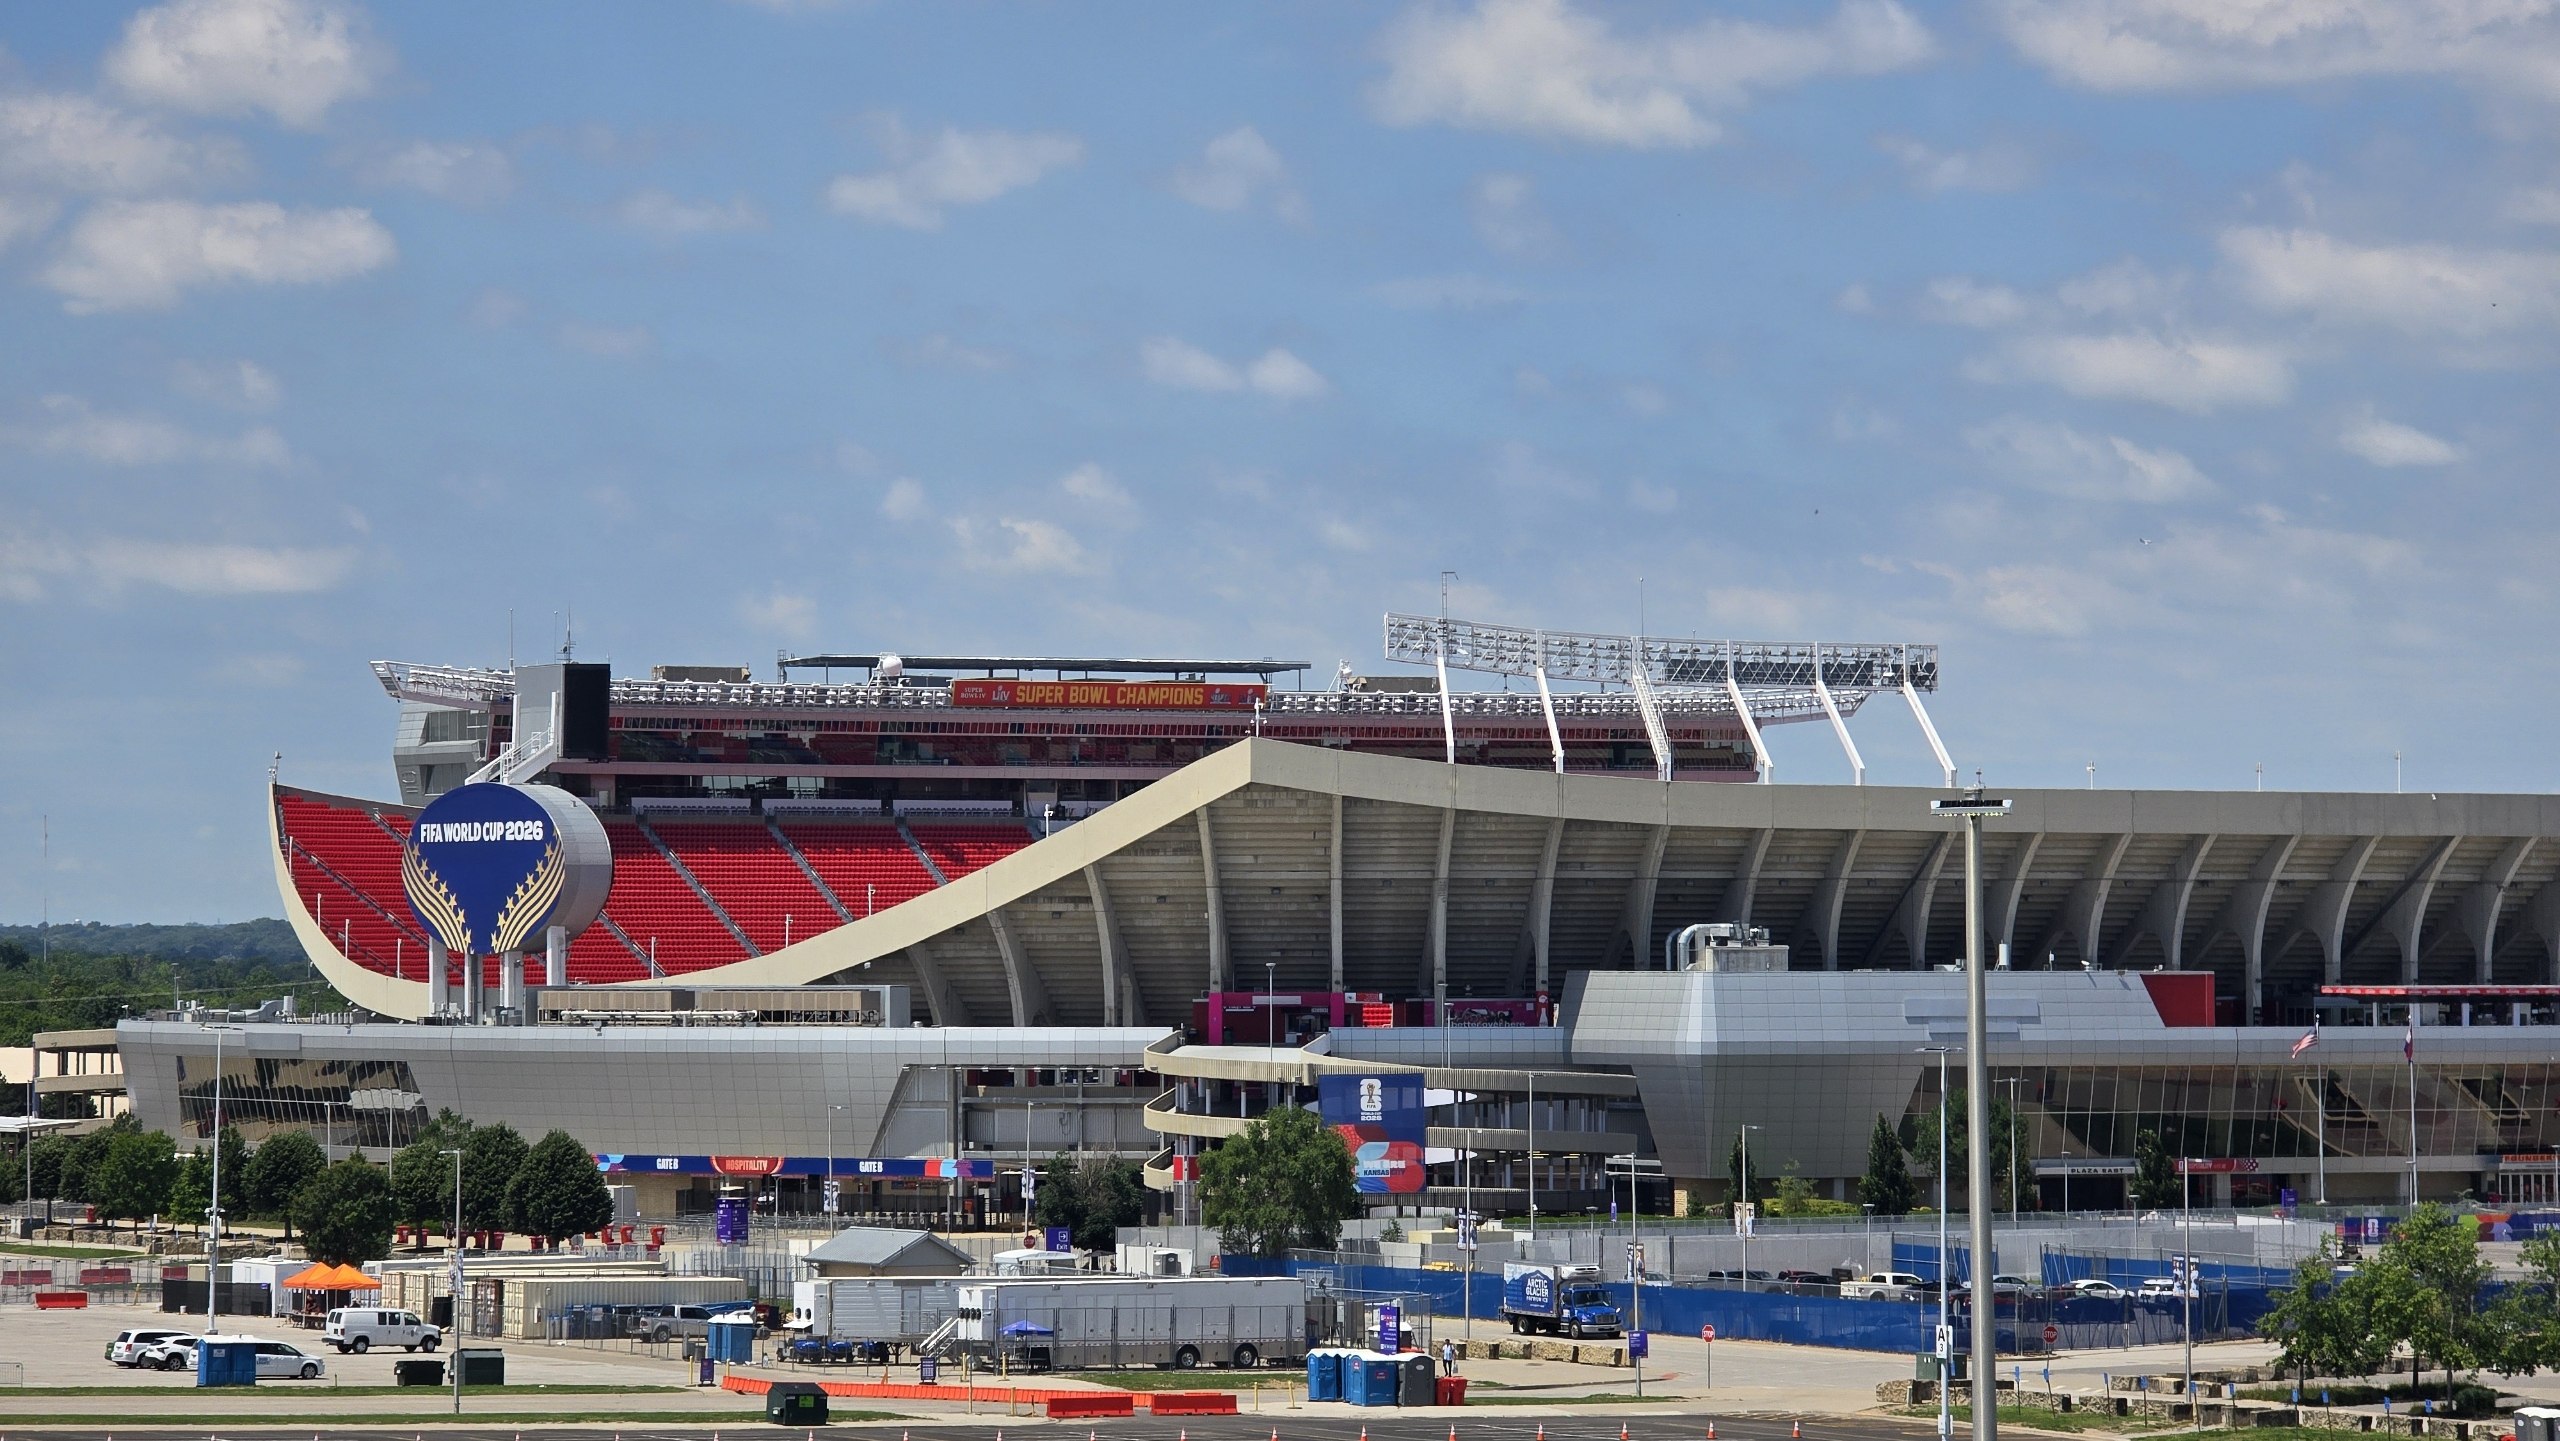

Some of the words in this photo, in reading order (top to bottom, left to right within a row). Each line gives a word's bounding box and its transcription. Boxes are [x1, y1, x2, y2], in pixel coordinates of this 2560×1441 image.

[1016, 685, 1064, 703] SUPER
[1069, 686, 1111, 704] BOWL
[1116, 686, 1204, 705] CHAMPIONS
[420, 824, 443, 843] FIFA
[443, 822, 481, 842] WORLD
[482, 821, 504, 841] CUP
[505, 820, 543, 841] 2026
[656, 1158, 673, 1170] GATE
[673, 1158, 679, 1170] B
[725, 1159, 768, 1171] HOSPITALITY
[859, 1161, 877, 1173] GATE
[877, 1161, 883, 1173] B
[1527, 1278, 1548, 1289] ARCTIC
[1525, 1286, 1548, 1298] GLACIER
[1703, 1330, 1714, 1338] STOP
[1938, 1327, 1946, 1342] A
[2044, 1330, 2058, 1339] STOP
[1939, 1343, 1944, 1352] 3
